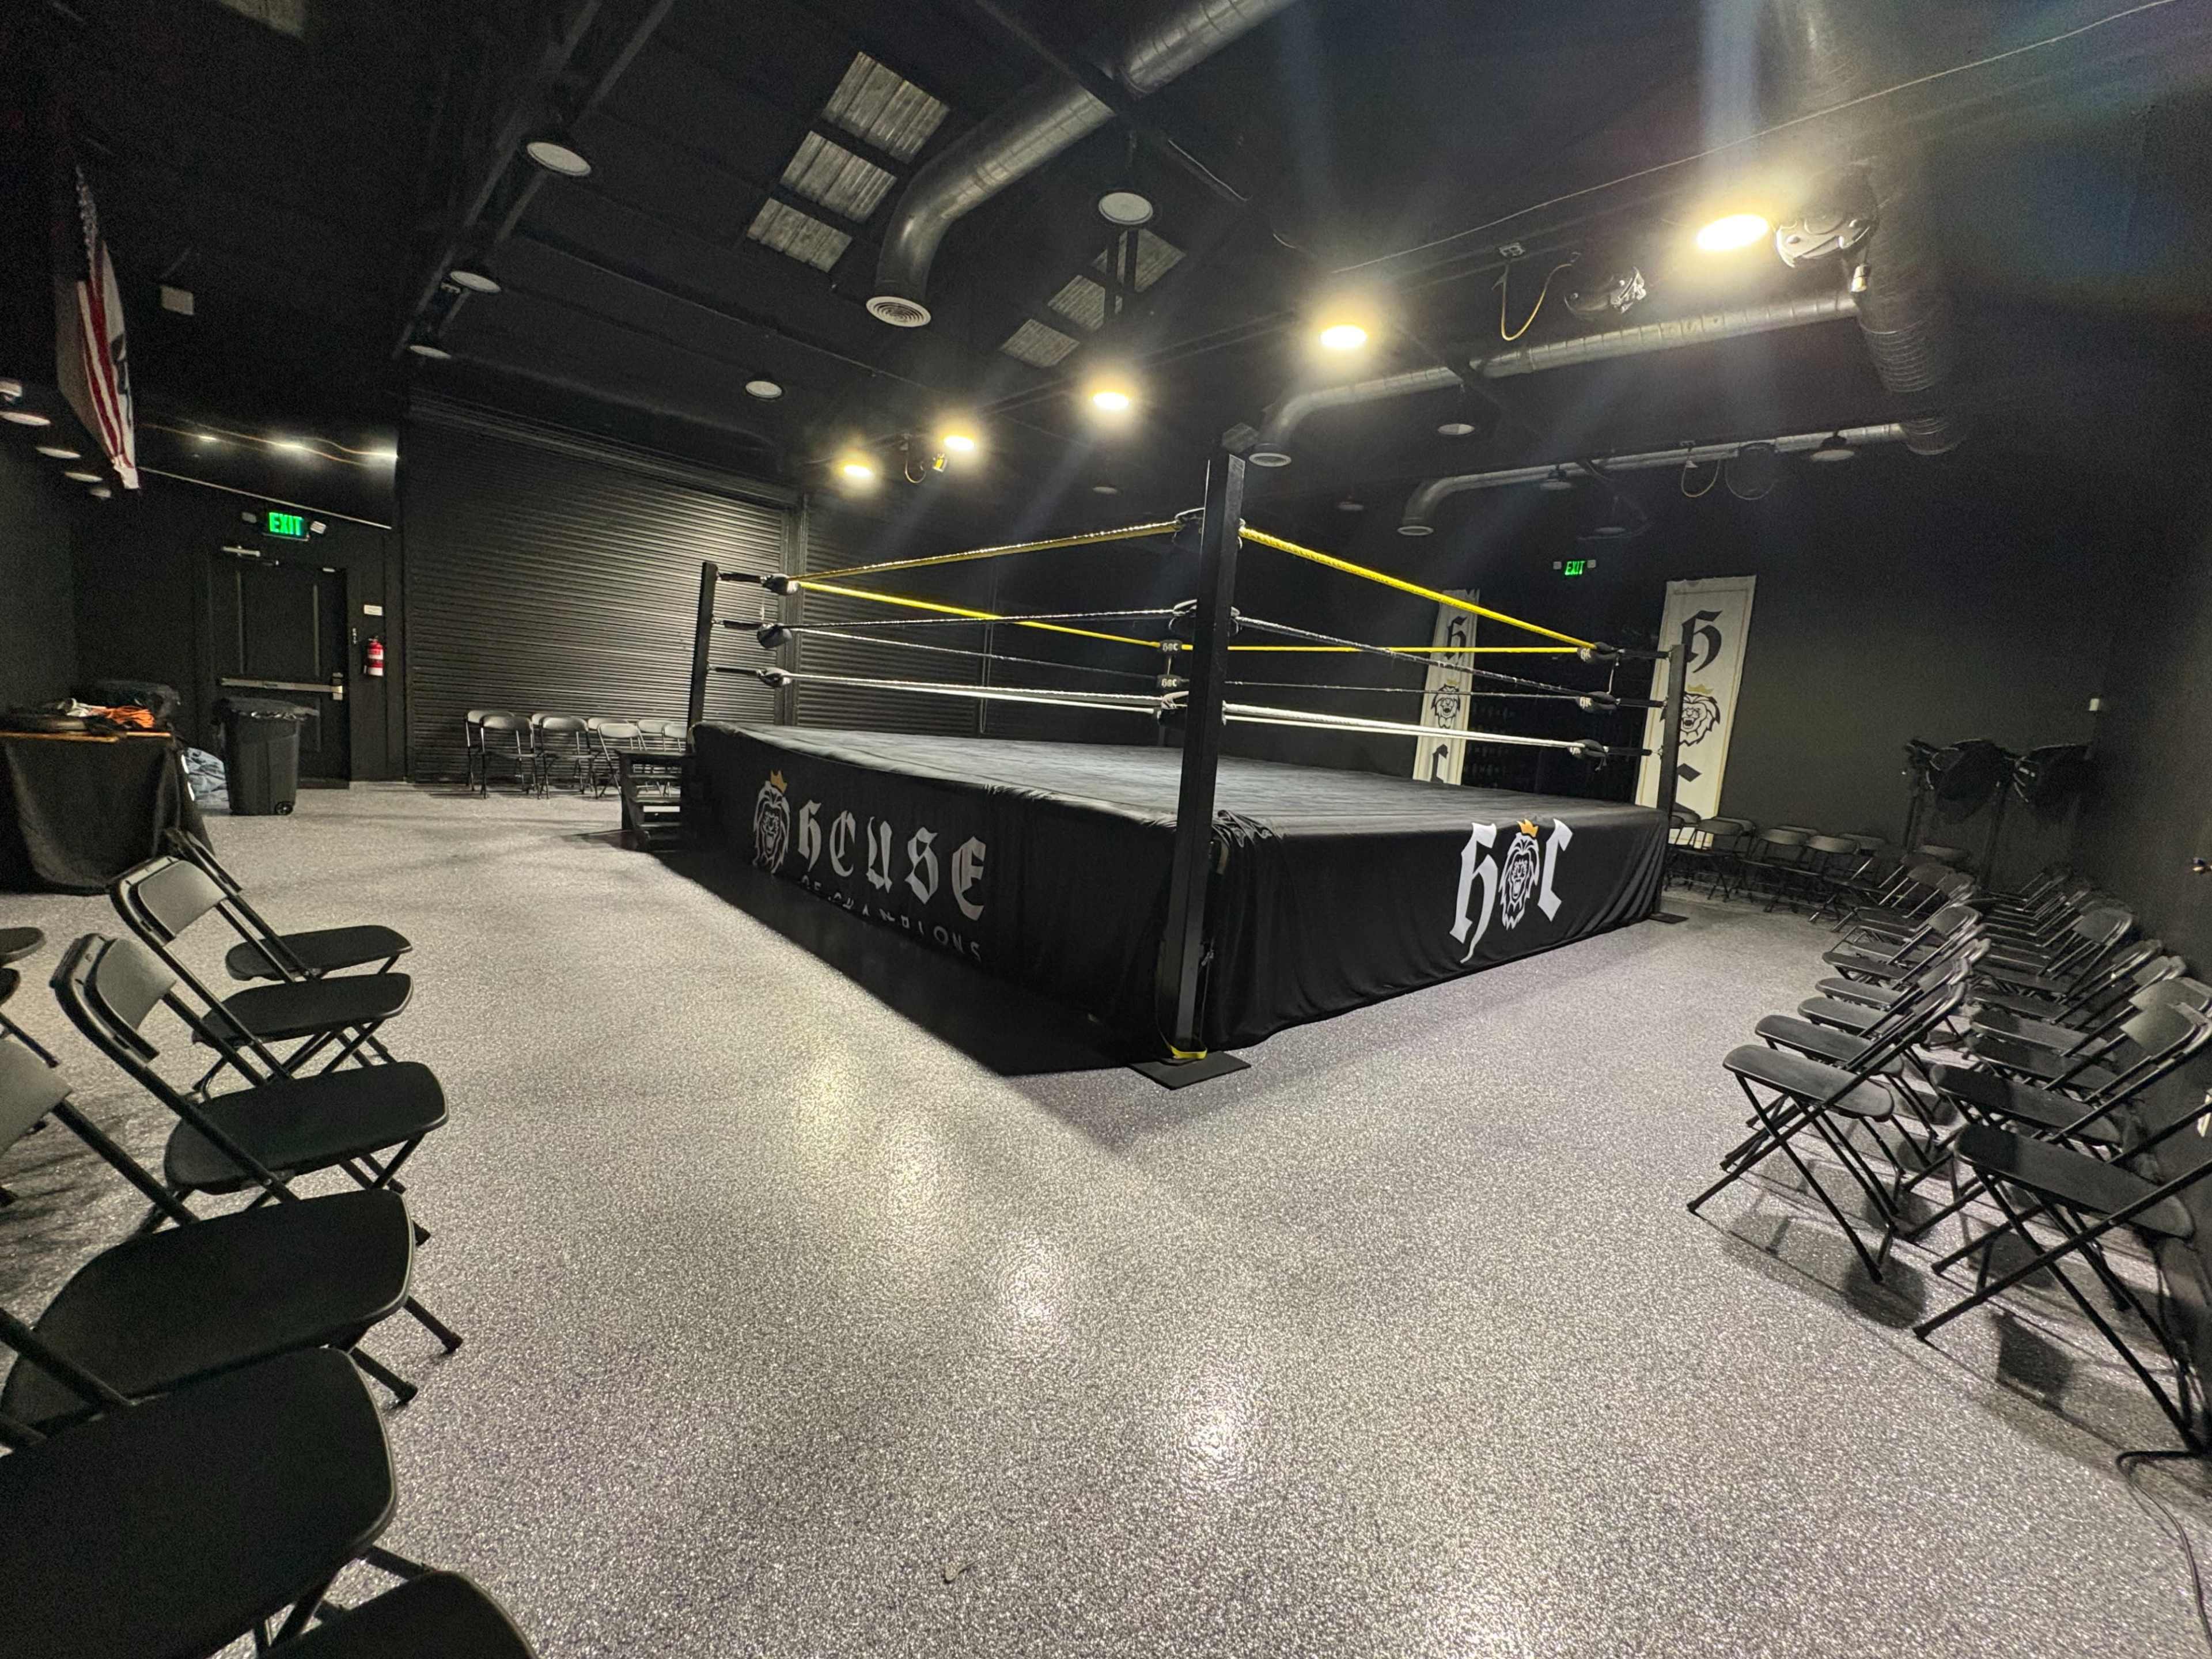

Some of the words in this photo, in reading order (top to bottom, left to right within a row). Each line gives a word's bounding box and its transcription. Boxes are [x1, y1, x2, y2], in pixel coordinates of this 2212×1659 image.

[268, 512, 304, 536] EXIT
[1565, 560, 1585, 575] EXIT
[798, 799, 987, 922] HOUSE
